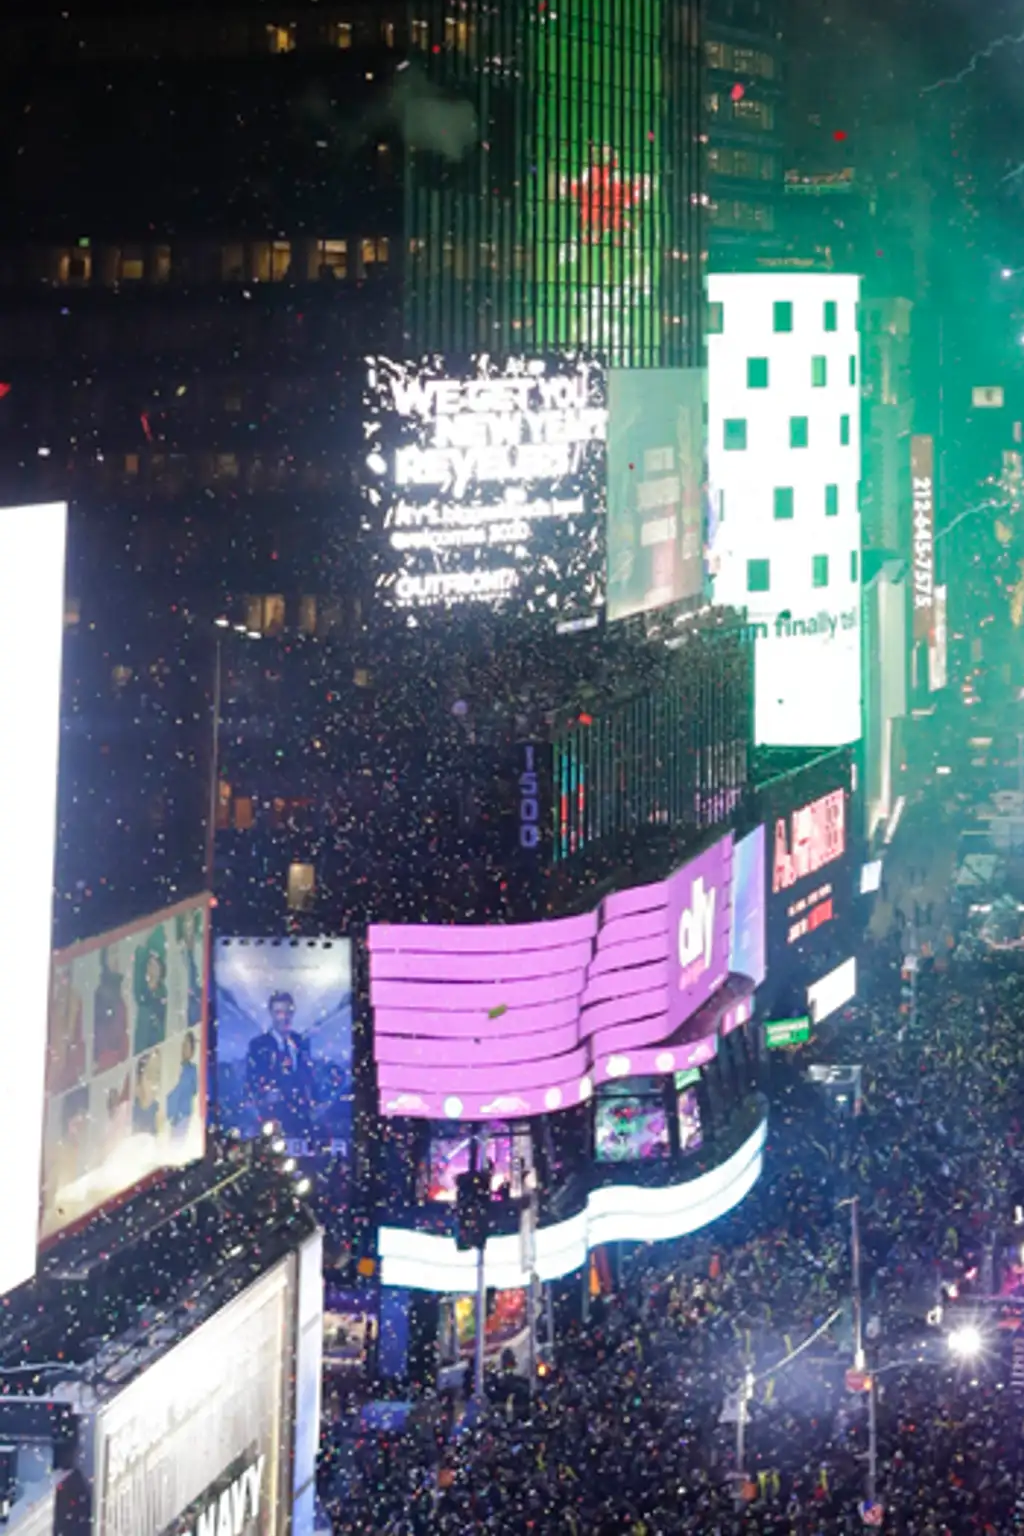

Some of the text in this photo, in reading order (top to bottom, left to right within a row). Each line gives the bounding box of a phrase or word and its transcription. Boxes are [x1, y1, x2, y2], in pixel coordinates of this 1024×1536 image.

[538, 375, 589, 407] YOU
[913, 476, 932, 608] 212-645-7575
[775, 610, 837, 638] finally
[678, 876, 716, 969] ally
